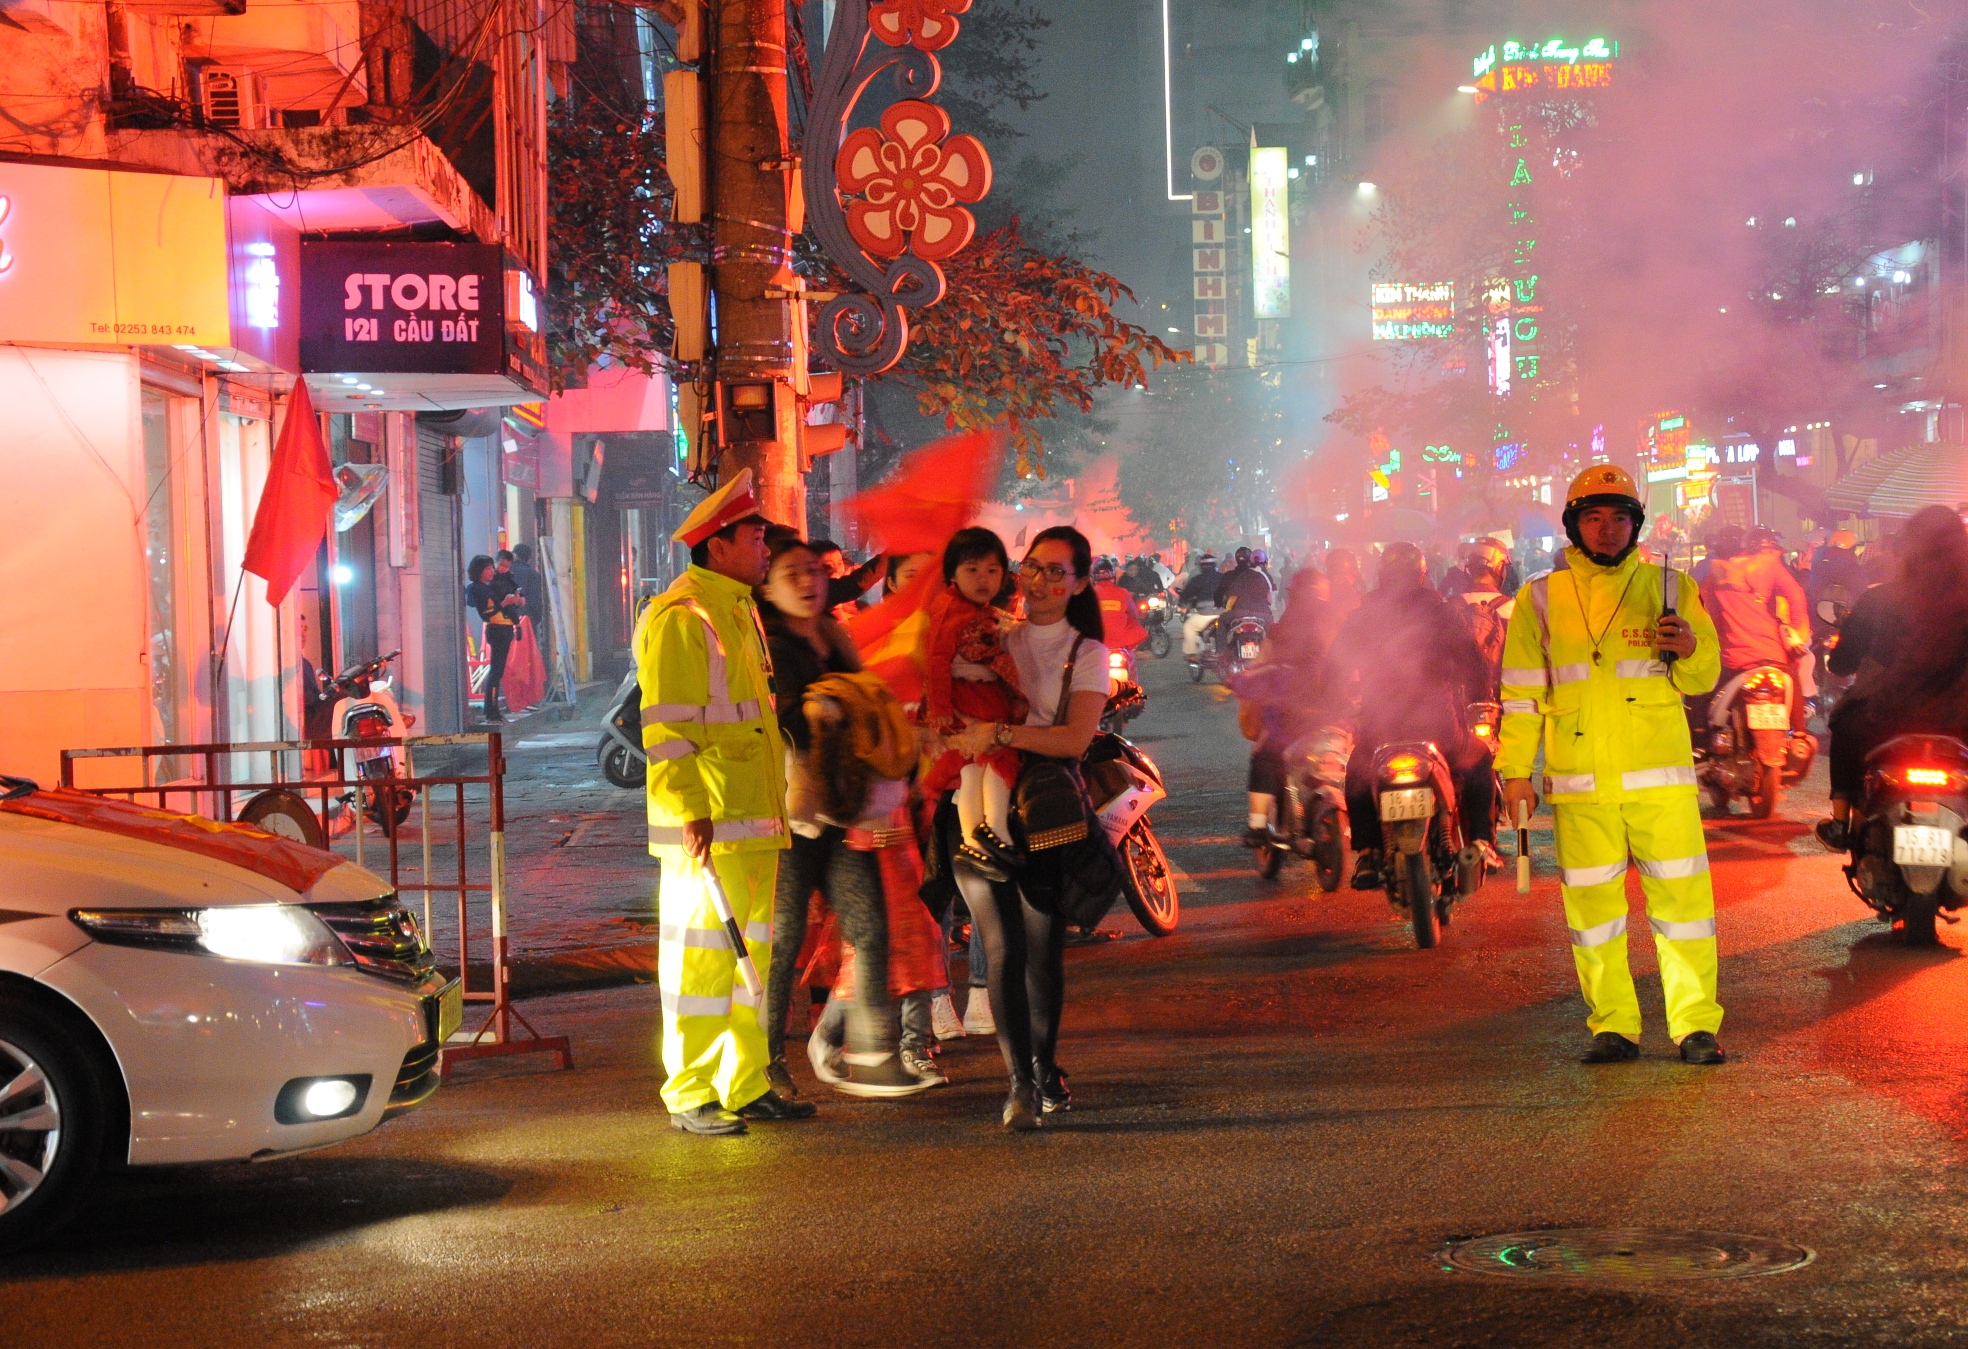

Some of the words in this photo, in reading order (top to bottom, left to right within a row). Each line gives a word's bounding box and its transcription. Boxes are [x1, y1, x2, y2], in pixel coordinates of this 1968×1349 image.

[344, 273, 479, 310] STORE
[90, 322, 111, 333] Tel:
[113, 323, 147, 335] 02253
[151, 324, 172, 336] 843
[176, 325, 196, 336] 474
[344, 317, 378, 342] 121
[393, 312, 434, 342] CẦU
[441, 312, 479, 342] ĐẤT
[1627, 640, 1652, 648] POLICE
[1106, 812, 1128, 826] YAMAHA
